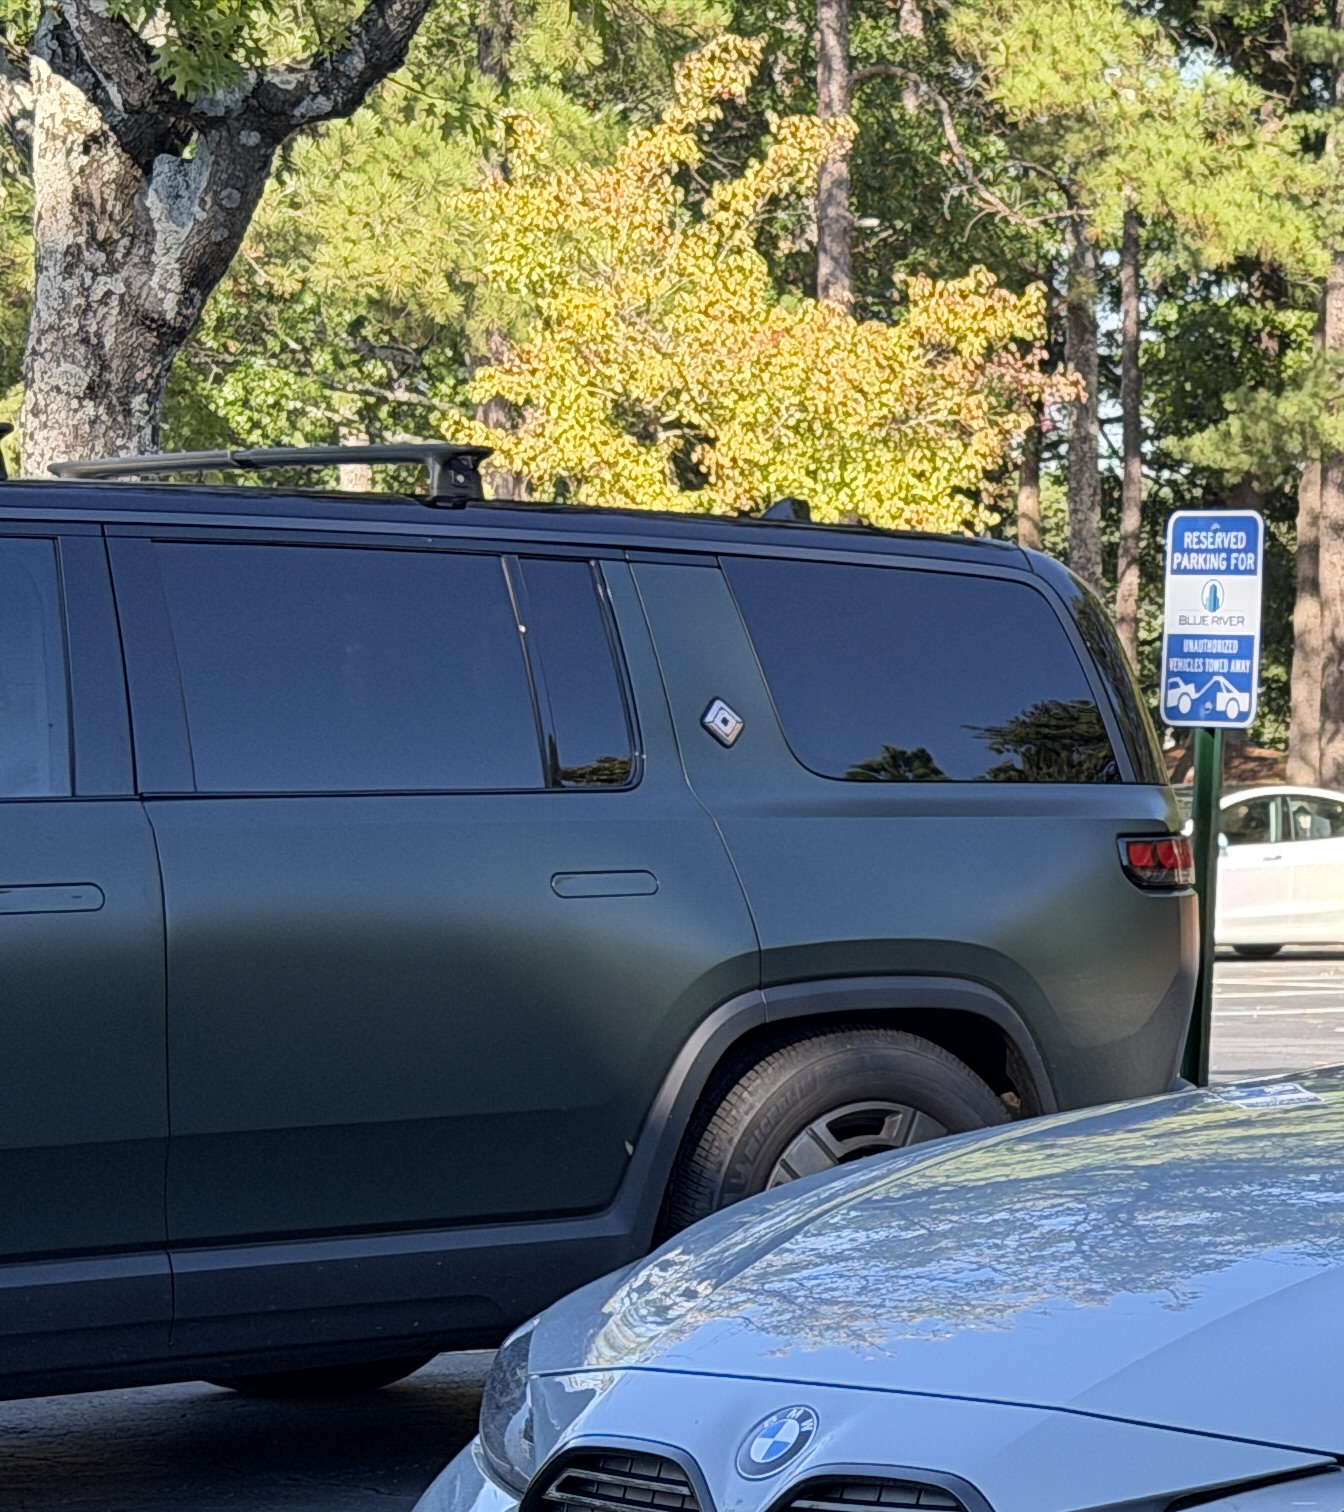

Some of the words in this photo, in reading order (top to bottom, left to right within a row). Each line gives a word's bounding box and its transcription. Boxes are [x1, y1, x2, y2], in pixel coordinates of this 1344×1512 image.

[1183, 531, 1247, 550] RESERVED
[1172, 552, 1227, 570] PARKING
[1230, 552, 1255, 570] FOR
[1178, 614, 1209, 626] BLUE
[1211, 615, 1246, 627] RIVER
